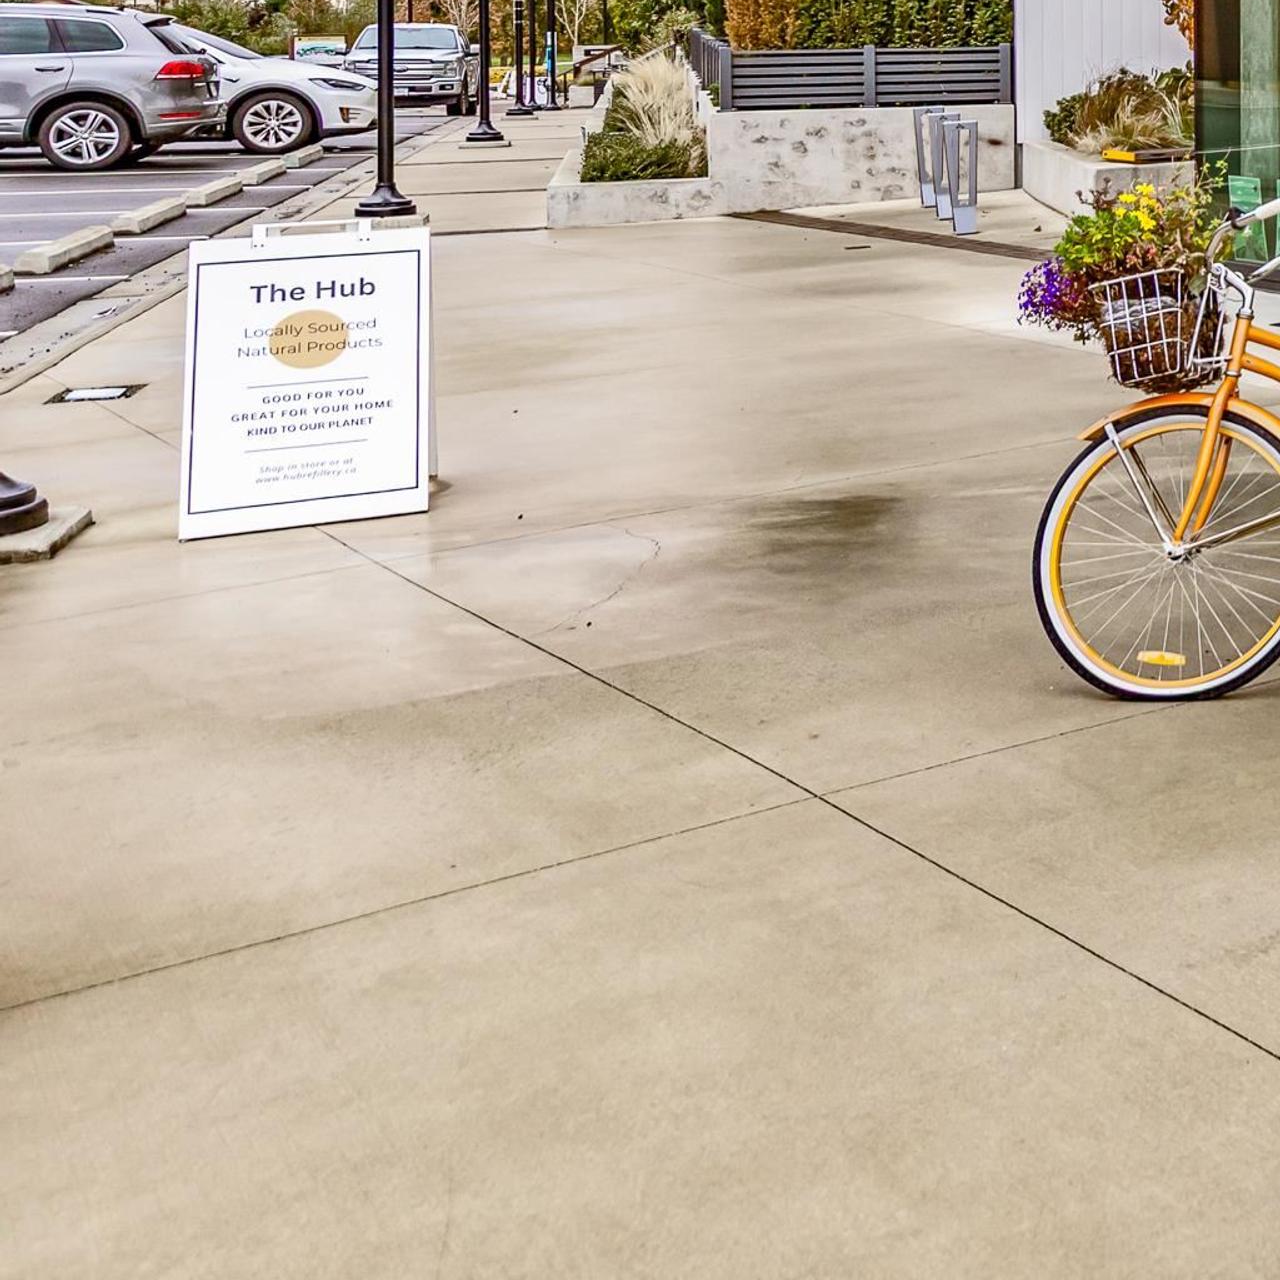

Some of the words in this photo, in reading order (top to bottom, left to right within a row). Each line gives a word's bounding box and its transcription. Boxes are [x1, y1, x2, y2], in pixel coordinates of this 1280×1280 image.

[250, 283, 306, 303] The
[316, 277, 376, 299] Hub
[244, 324, 304, 339] Locally
[307, 317, 377, 334] Sourced
[237, 342, 302, 358] Natural
[307, 337, 383, 353] Products
[262, 393, 302, 404] GOOD
[307, 390, 333, 400] FOR
[338, 387, 365, 397] YOU
[231, 410, 276, 423] GREAT
[281, 408, 308, 418] FOR
[313, 404, 350, 416] YOUR
[354, 399, 393, 411] HOME
[247, 426, 278, 437] KIND
[281, 424, 297, 434] TO
[299, 422, 326, 432] OUR
[328, 416, 374, 429] PLANET
